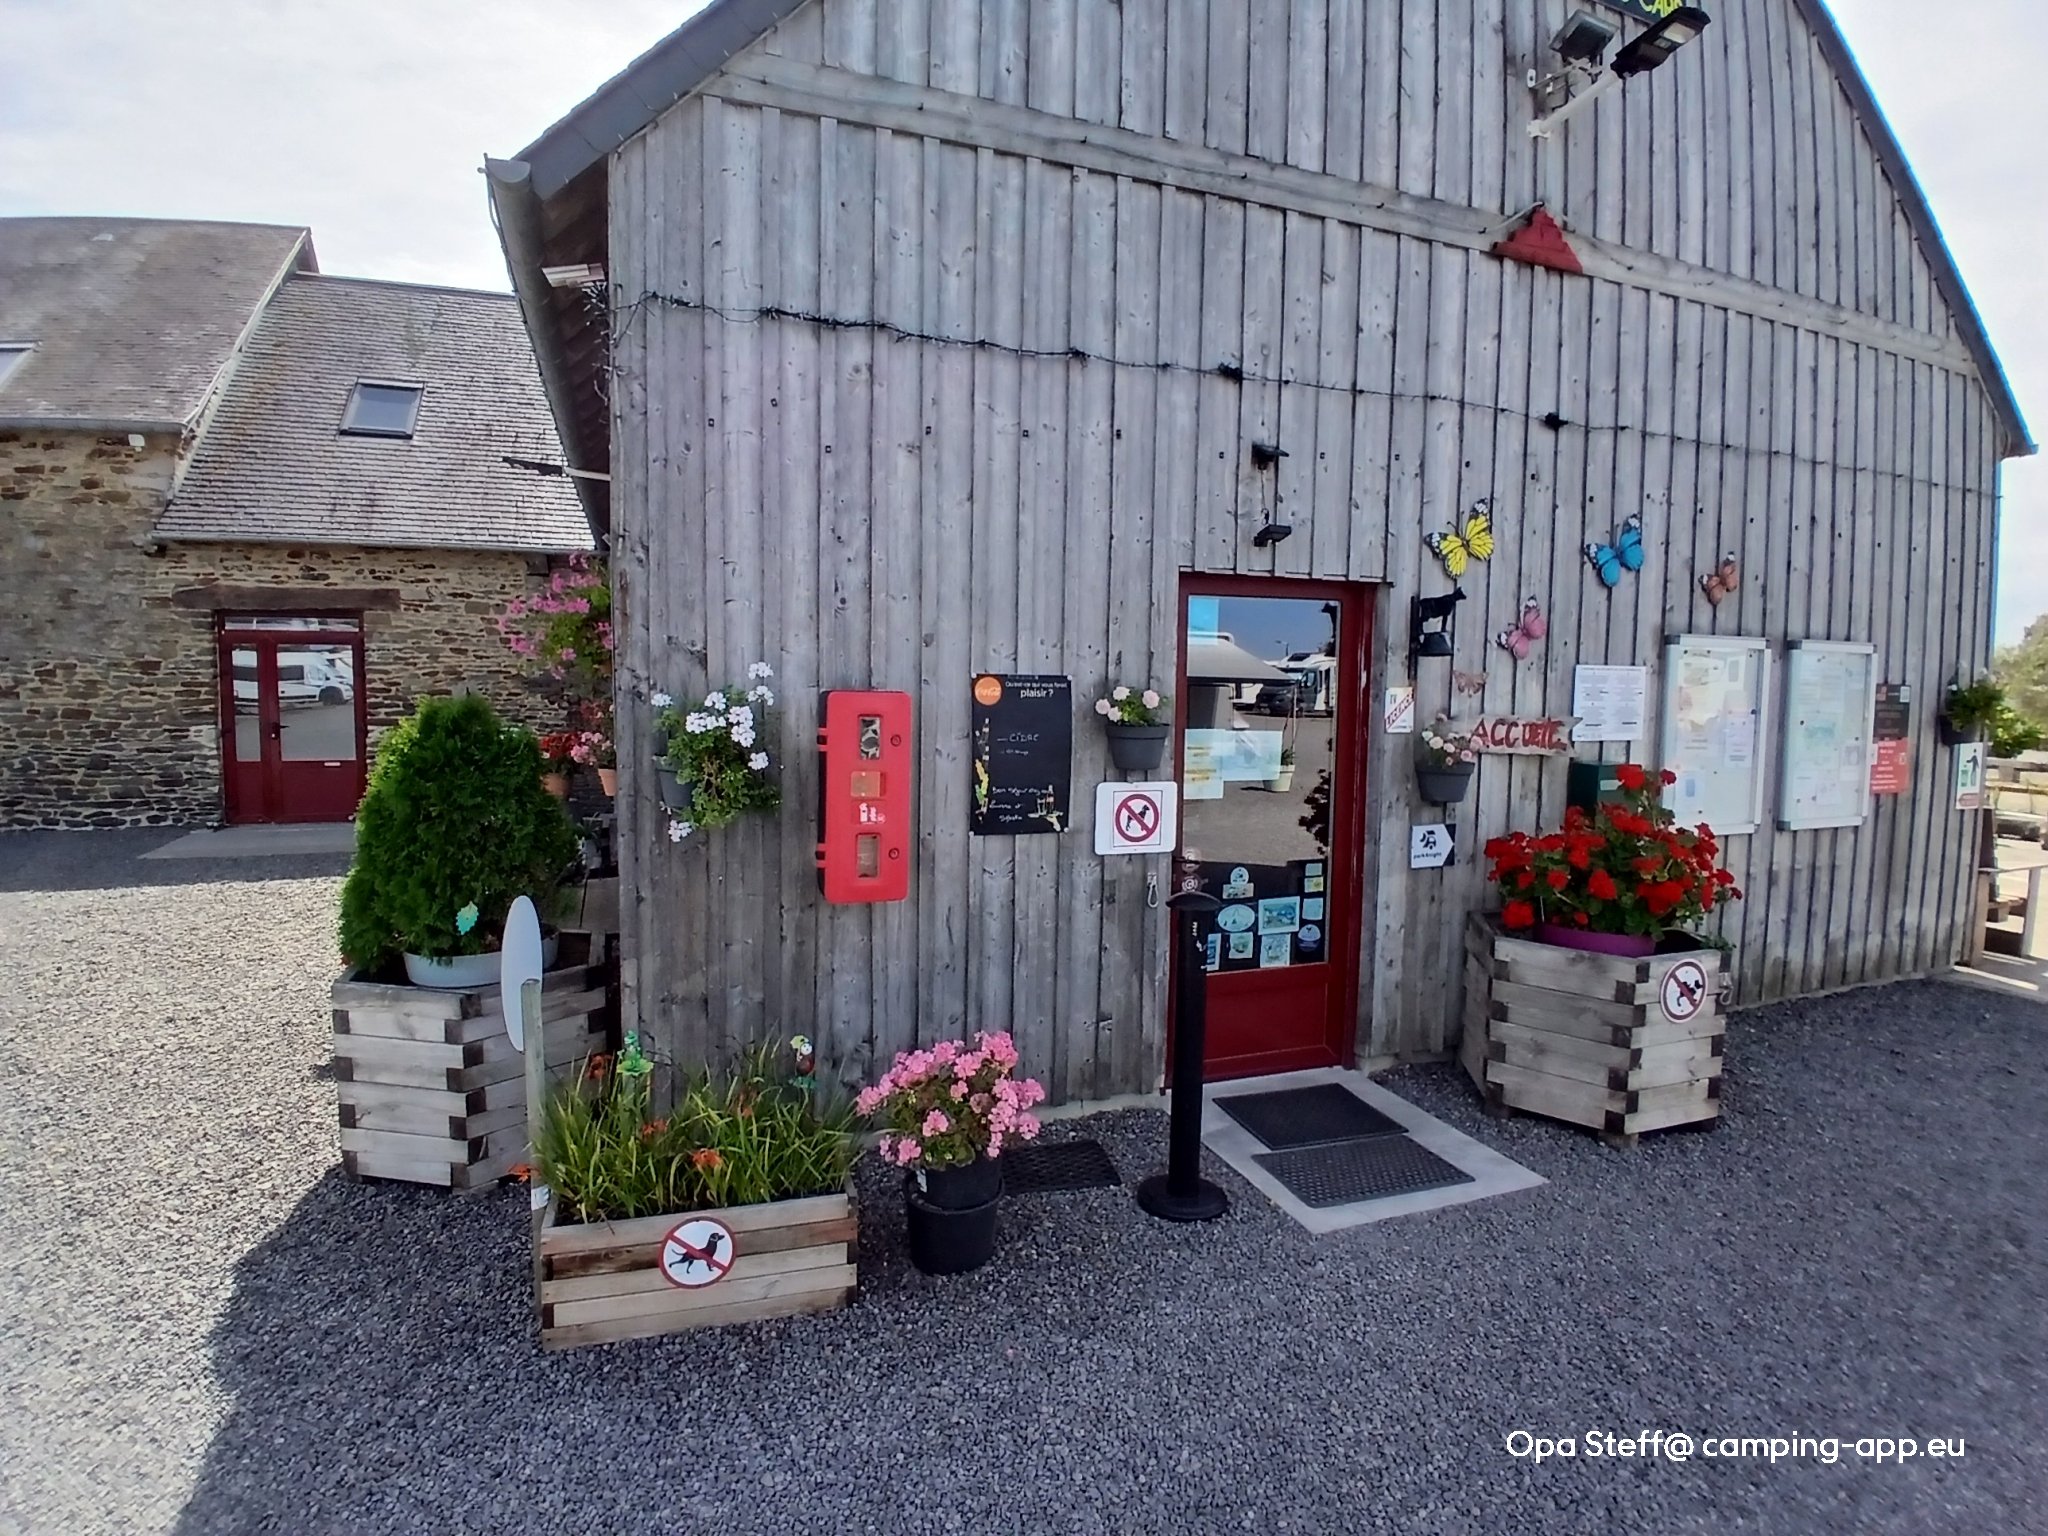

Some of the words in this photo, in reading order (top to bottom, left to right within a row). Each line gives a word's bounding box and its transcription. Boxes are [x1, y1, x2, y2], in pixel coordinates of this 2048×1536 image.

[1020, 688, 1047, 699] plaisir
[1048, 688, 1054, 698] ?
[1468, 717, 1568, 752] ACCUEIL
